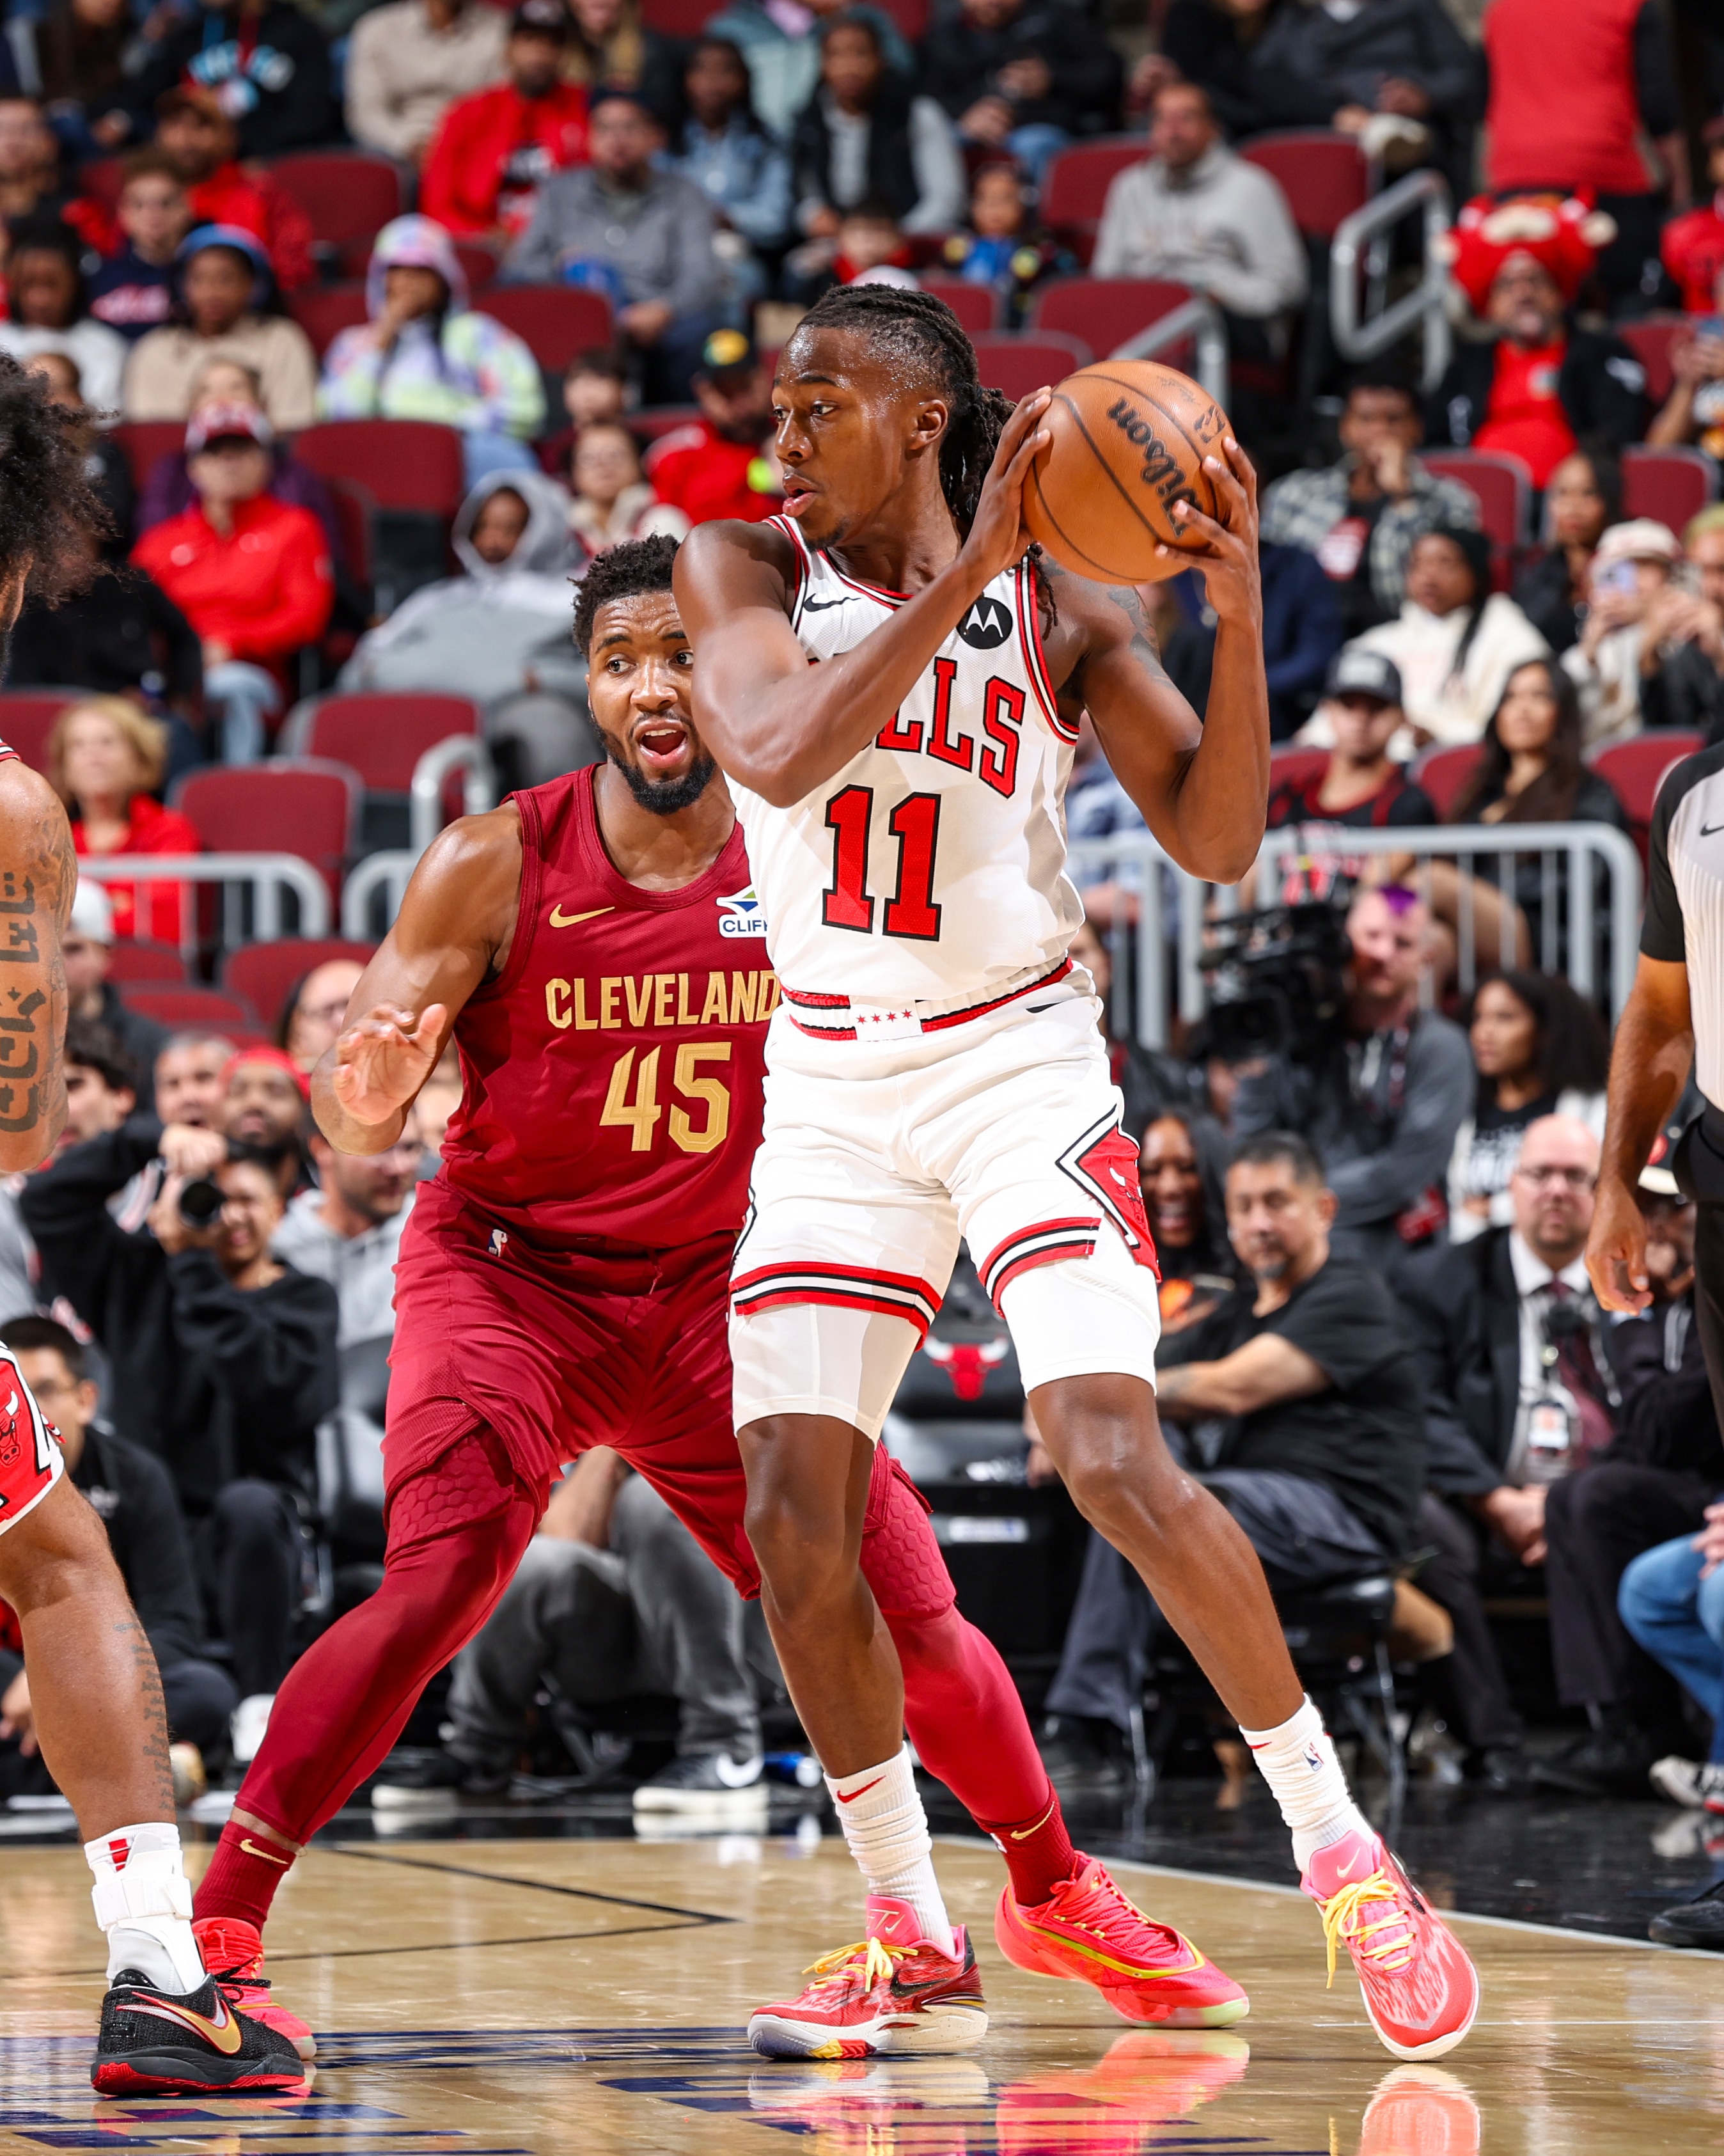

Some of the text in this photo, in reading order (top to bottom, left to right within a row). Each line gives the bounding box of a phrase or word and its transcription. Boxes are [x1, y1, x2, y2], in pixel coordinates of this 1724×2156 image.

[860, 656, 1026, 799] LLS
[822, 784, 942, 942] 11
[545, 970, 781, 1030] CLEVELAND
[599, 1041, 732, 1154] 45
